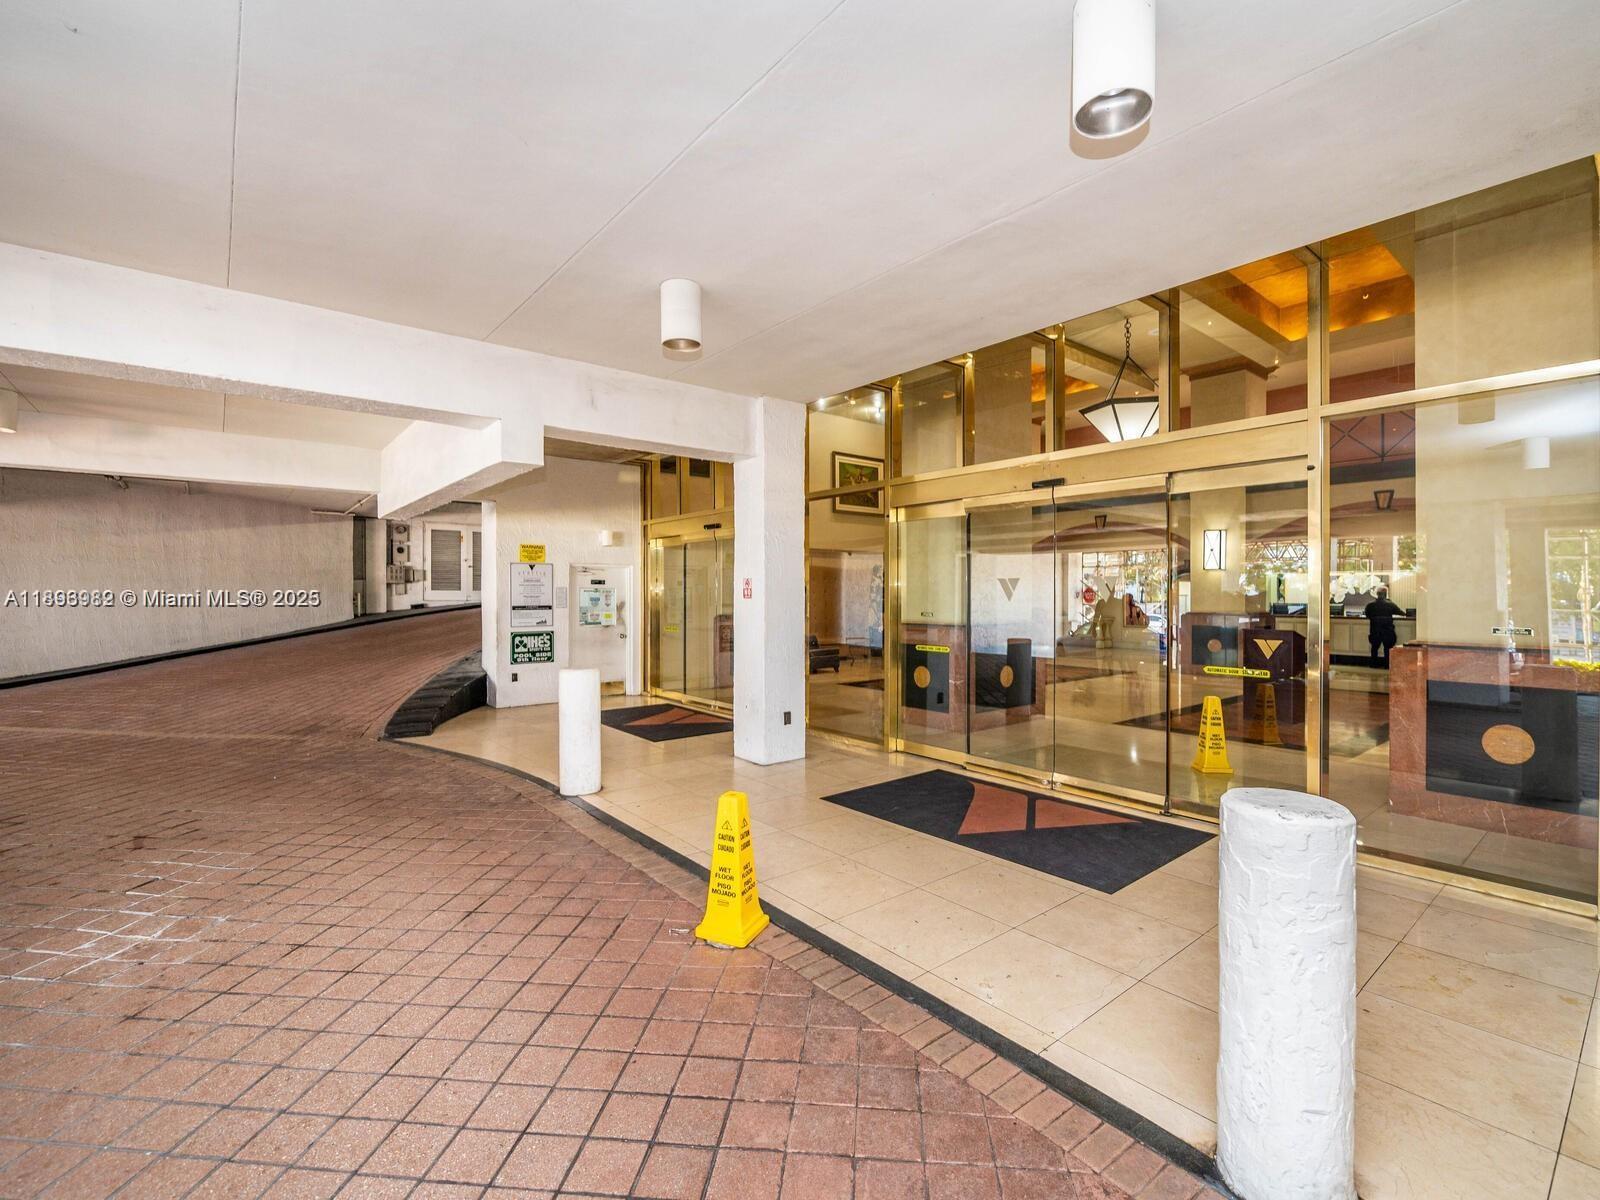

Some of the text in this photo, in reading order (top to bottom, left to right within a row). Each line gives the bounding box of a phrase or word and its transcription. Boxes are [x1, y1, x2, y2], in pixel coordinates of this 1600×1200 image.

[718, 833, 735, 842] CAUTION
[718, 844, 734, 853] CUIDADO
[719, 866, 731, 874] WET
[715, 872, 735, 881] FLOOR
[717, 882, 731, 890] PISO
[711, 888, 736, 898] MOJADO
